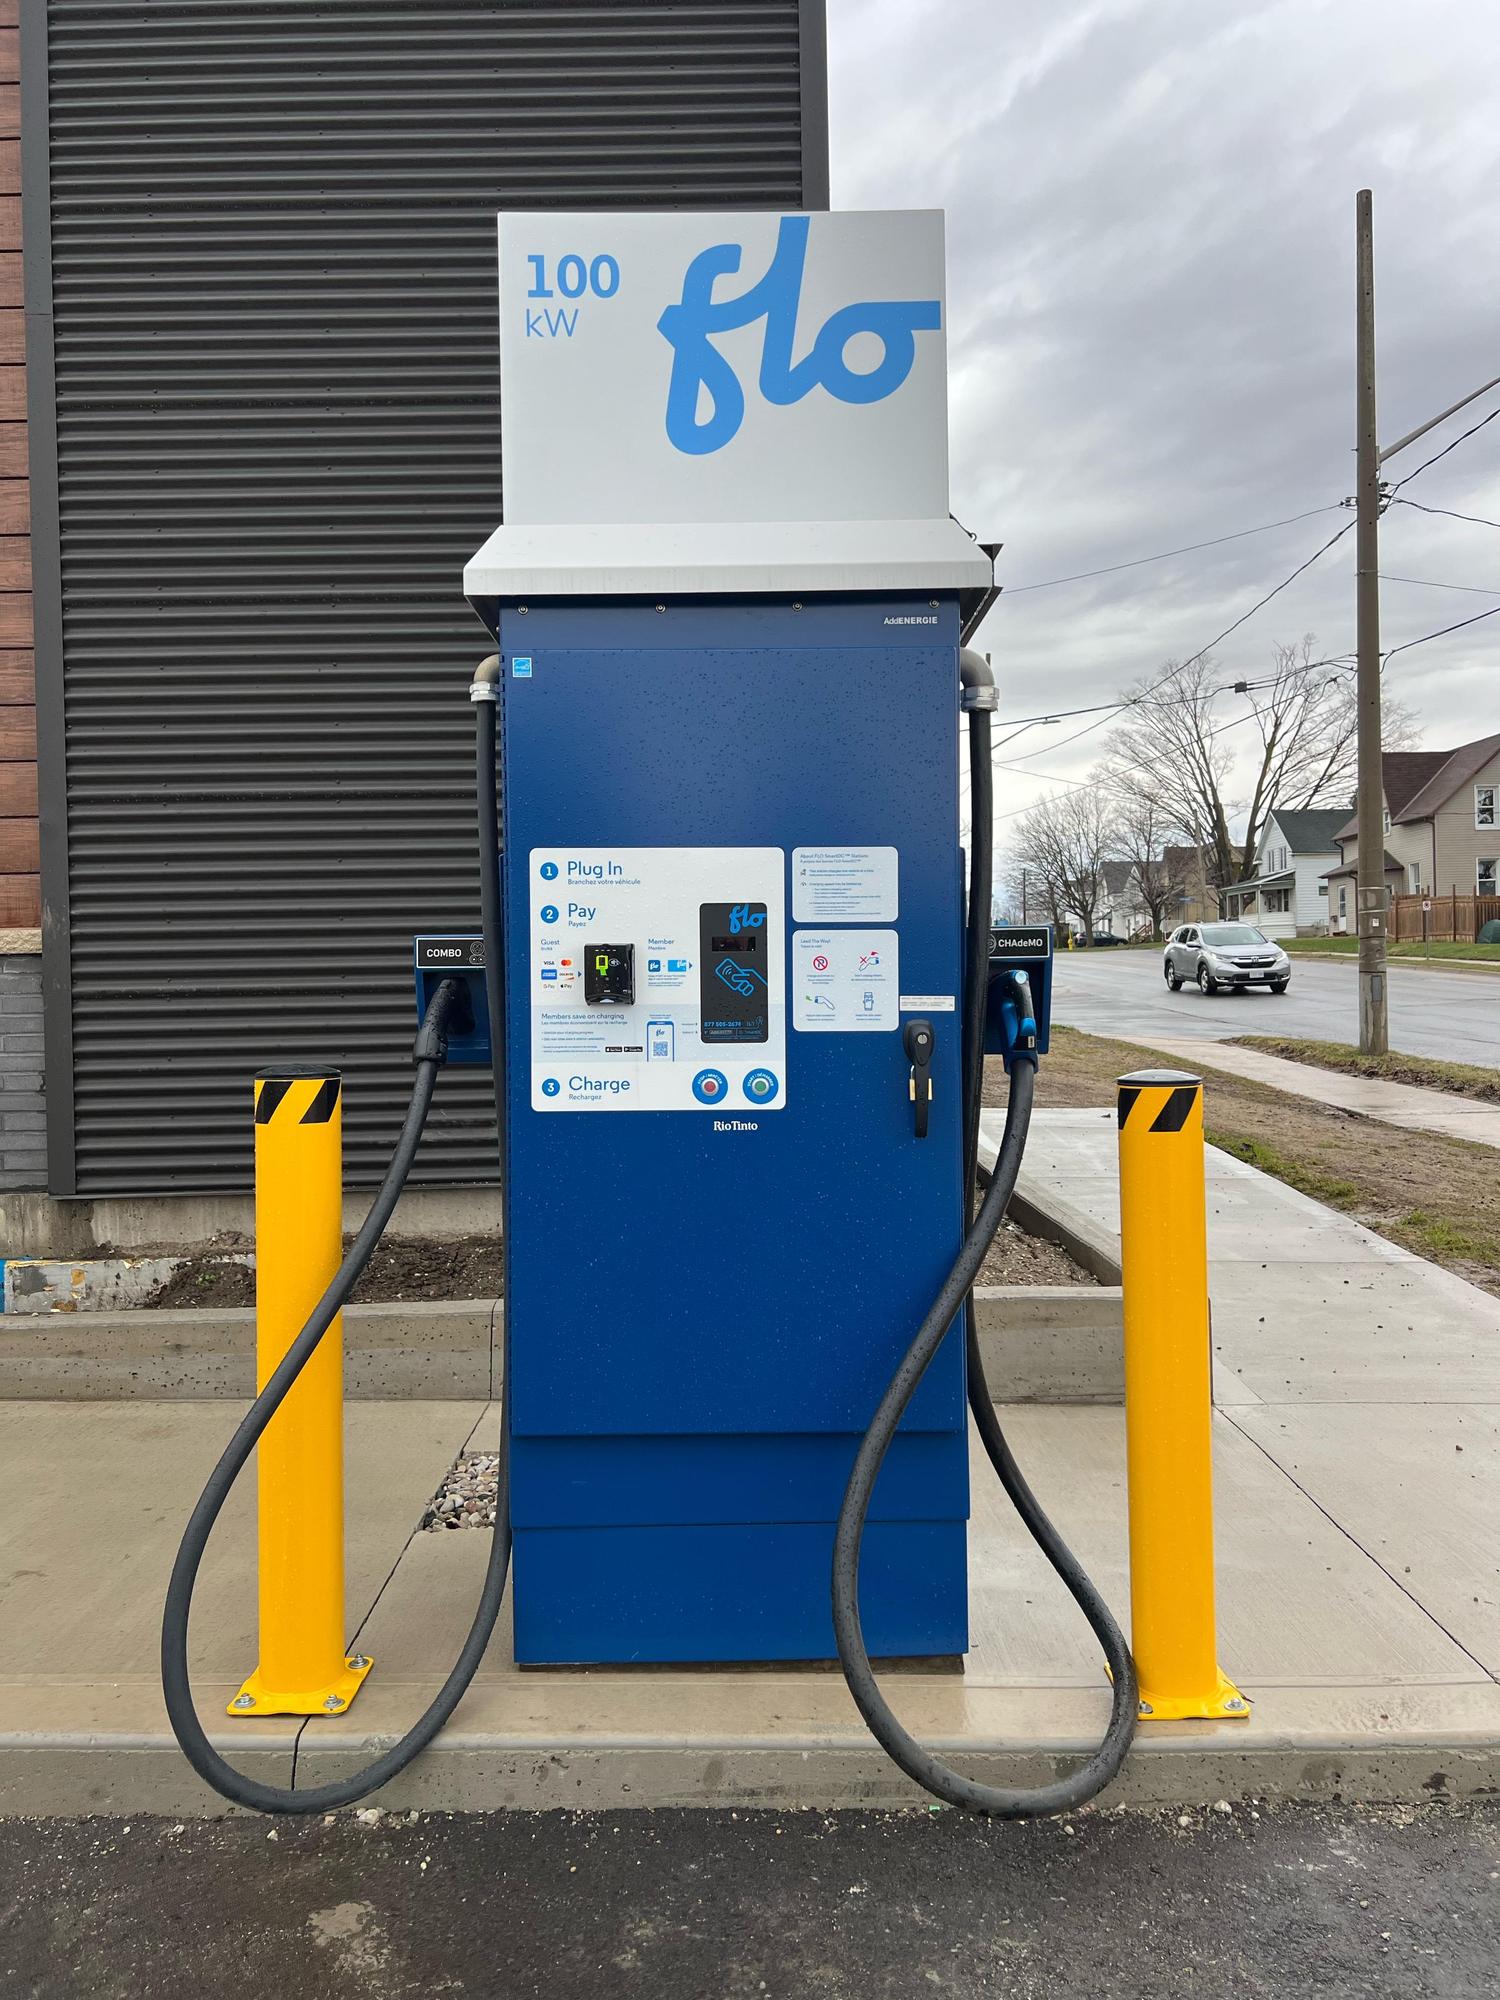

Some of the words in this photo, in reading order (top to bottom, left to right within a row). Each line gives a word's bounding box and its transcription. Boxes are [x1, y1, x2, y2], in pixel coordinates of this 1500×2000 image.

[527, 254, 620, 298] 100
[526, 308, 578, 337] kW
[657, 216, 941, 455] flo
[883, 616, 938, 624] AddENERGIE
[546, 866, 552, 876] 1
[568, 861, 603, 878] Plug
[608, 861, 622, 875] In
[546, 910, 553, 919] 2
[568, 903, 596, 920] Pay
[729, 904, 767, 933] flo
[998, 939, 1043, 947] CHAdeMO
[426, 949, 462, 957] COMBO
[547, 1083, 555, 1092] 3
[569, 1076, 630, 1093] Charge
